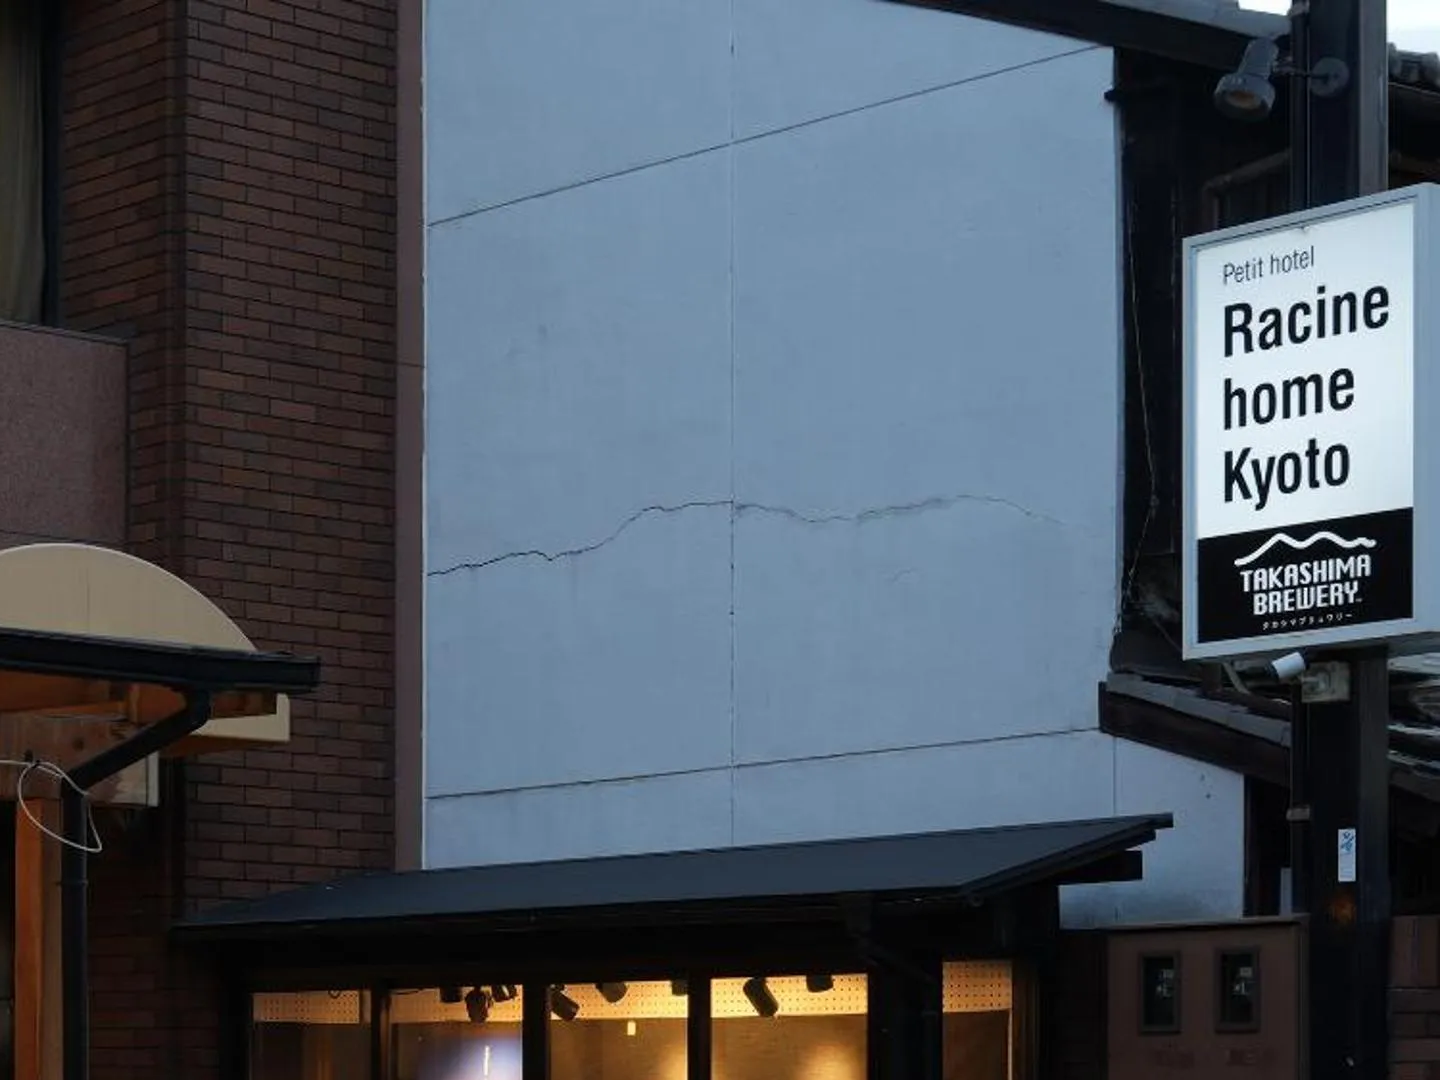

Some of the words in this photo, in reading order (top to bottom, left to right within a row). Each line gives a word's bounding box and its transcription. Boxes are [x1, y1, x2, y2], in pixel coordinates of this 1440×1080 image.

[1223, 261, 1263, 285] Petit
[1270, 245, 1314, 275] hotel
[1224, 285, 1389, 357] Racine
[1224, 368, 1354, 430] home
[1224, 438, 1349, 511] Kyoto
[1240, 554, 1371, 592] TAKASHIMA
[1253, 580, 1358, 615] BREWERY
